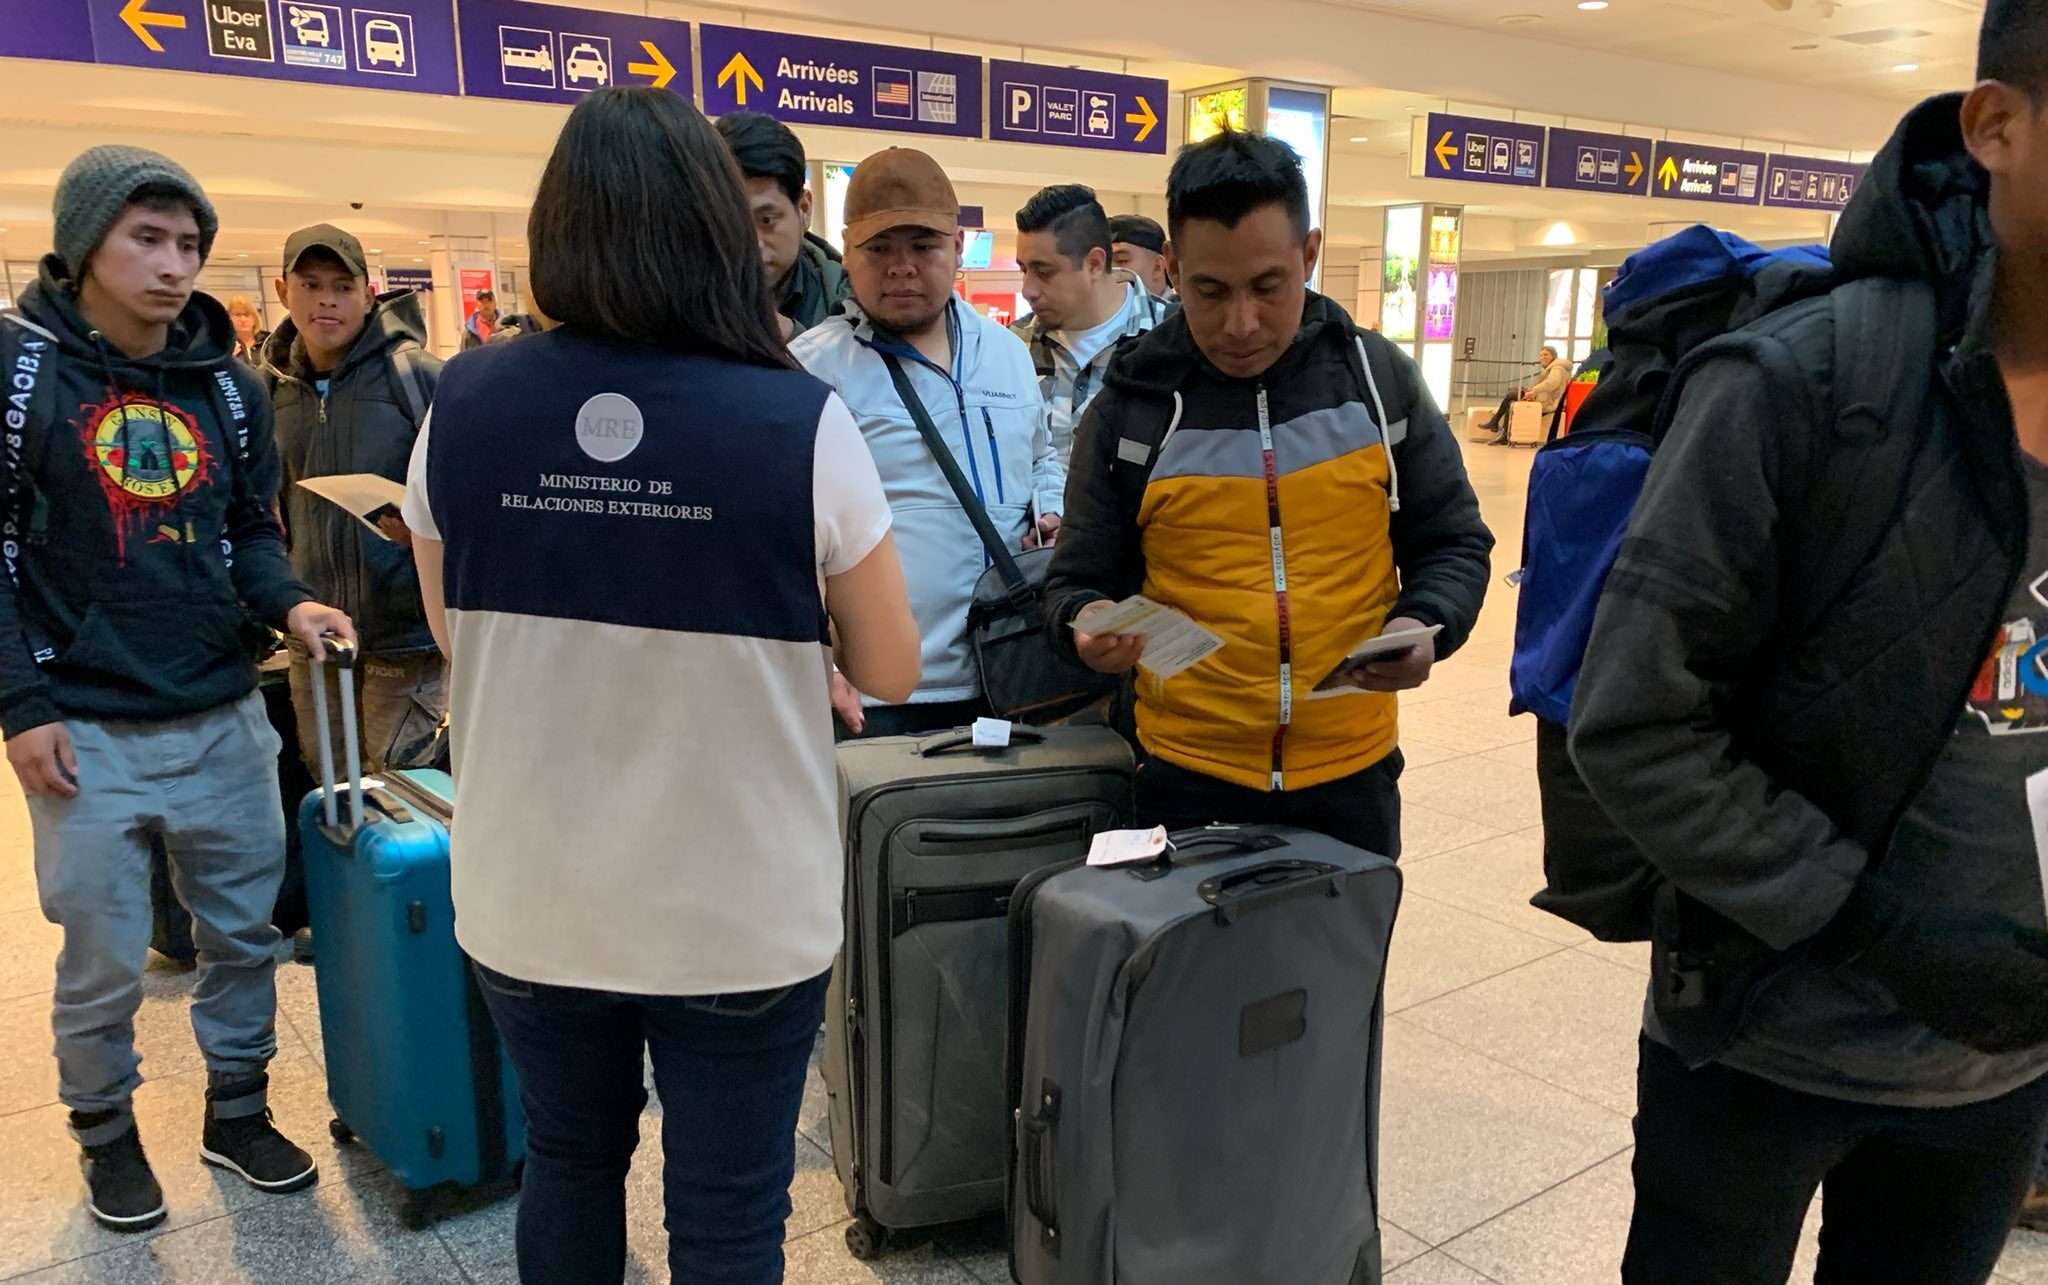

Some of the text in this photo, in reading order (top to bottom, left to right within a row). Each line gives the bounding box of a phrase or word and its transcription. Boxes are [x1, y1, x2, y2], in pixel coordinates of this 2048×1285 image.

[212, 4, 262, 27] Uber
[223, 29, 257, 51] Eva
[324, 53, 342, 65] 747
[777, 56, 859, 85] Arrivées
[778, 88, 854, 115] Arrivals
[1012, 89, 1031, 124] P
[1047, 101, 1074, 112] VALET
[1049, 111, 1072, 121] PARC
[1467, 141, 1485, 153] Uber
[1469, 155, 1481, 166] Eva
[1680, 178, 1713, 194] Arrivals
[1773, 172, 1784, 195] P
[582, 416, 636, 440] MRE
[539, 473, 672, 494] MINISTERIO DE
[501, 493, 712, 520] RELACIONES EXTERIORES
